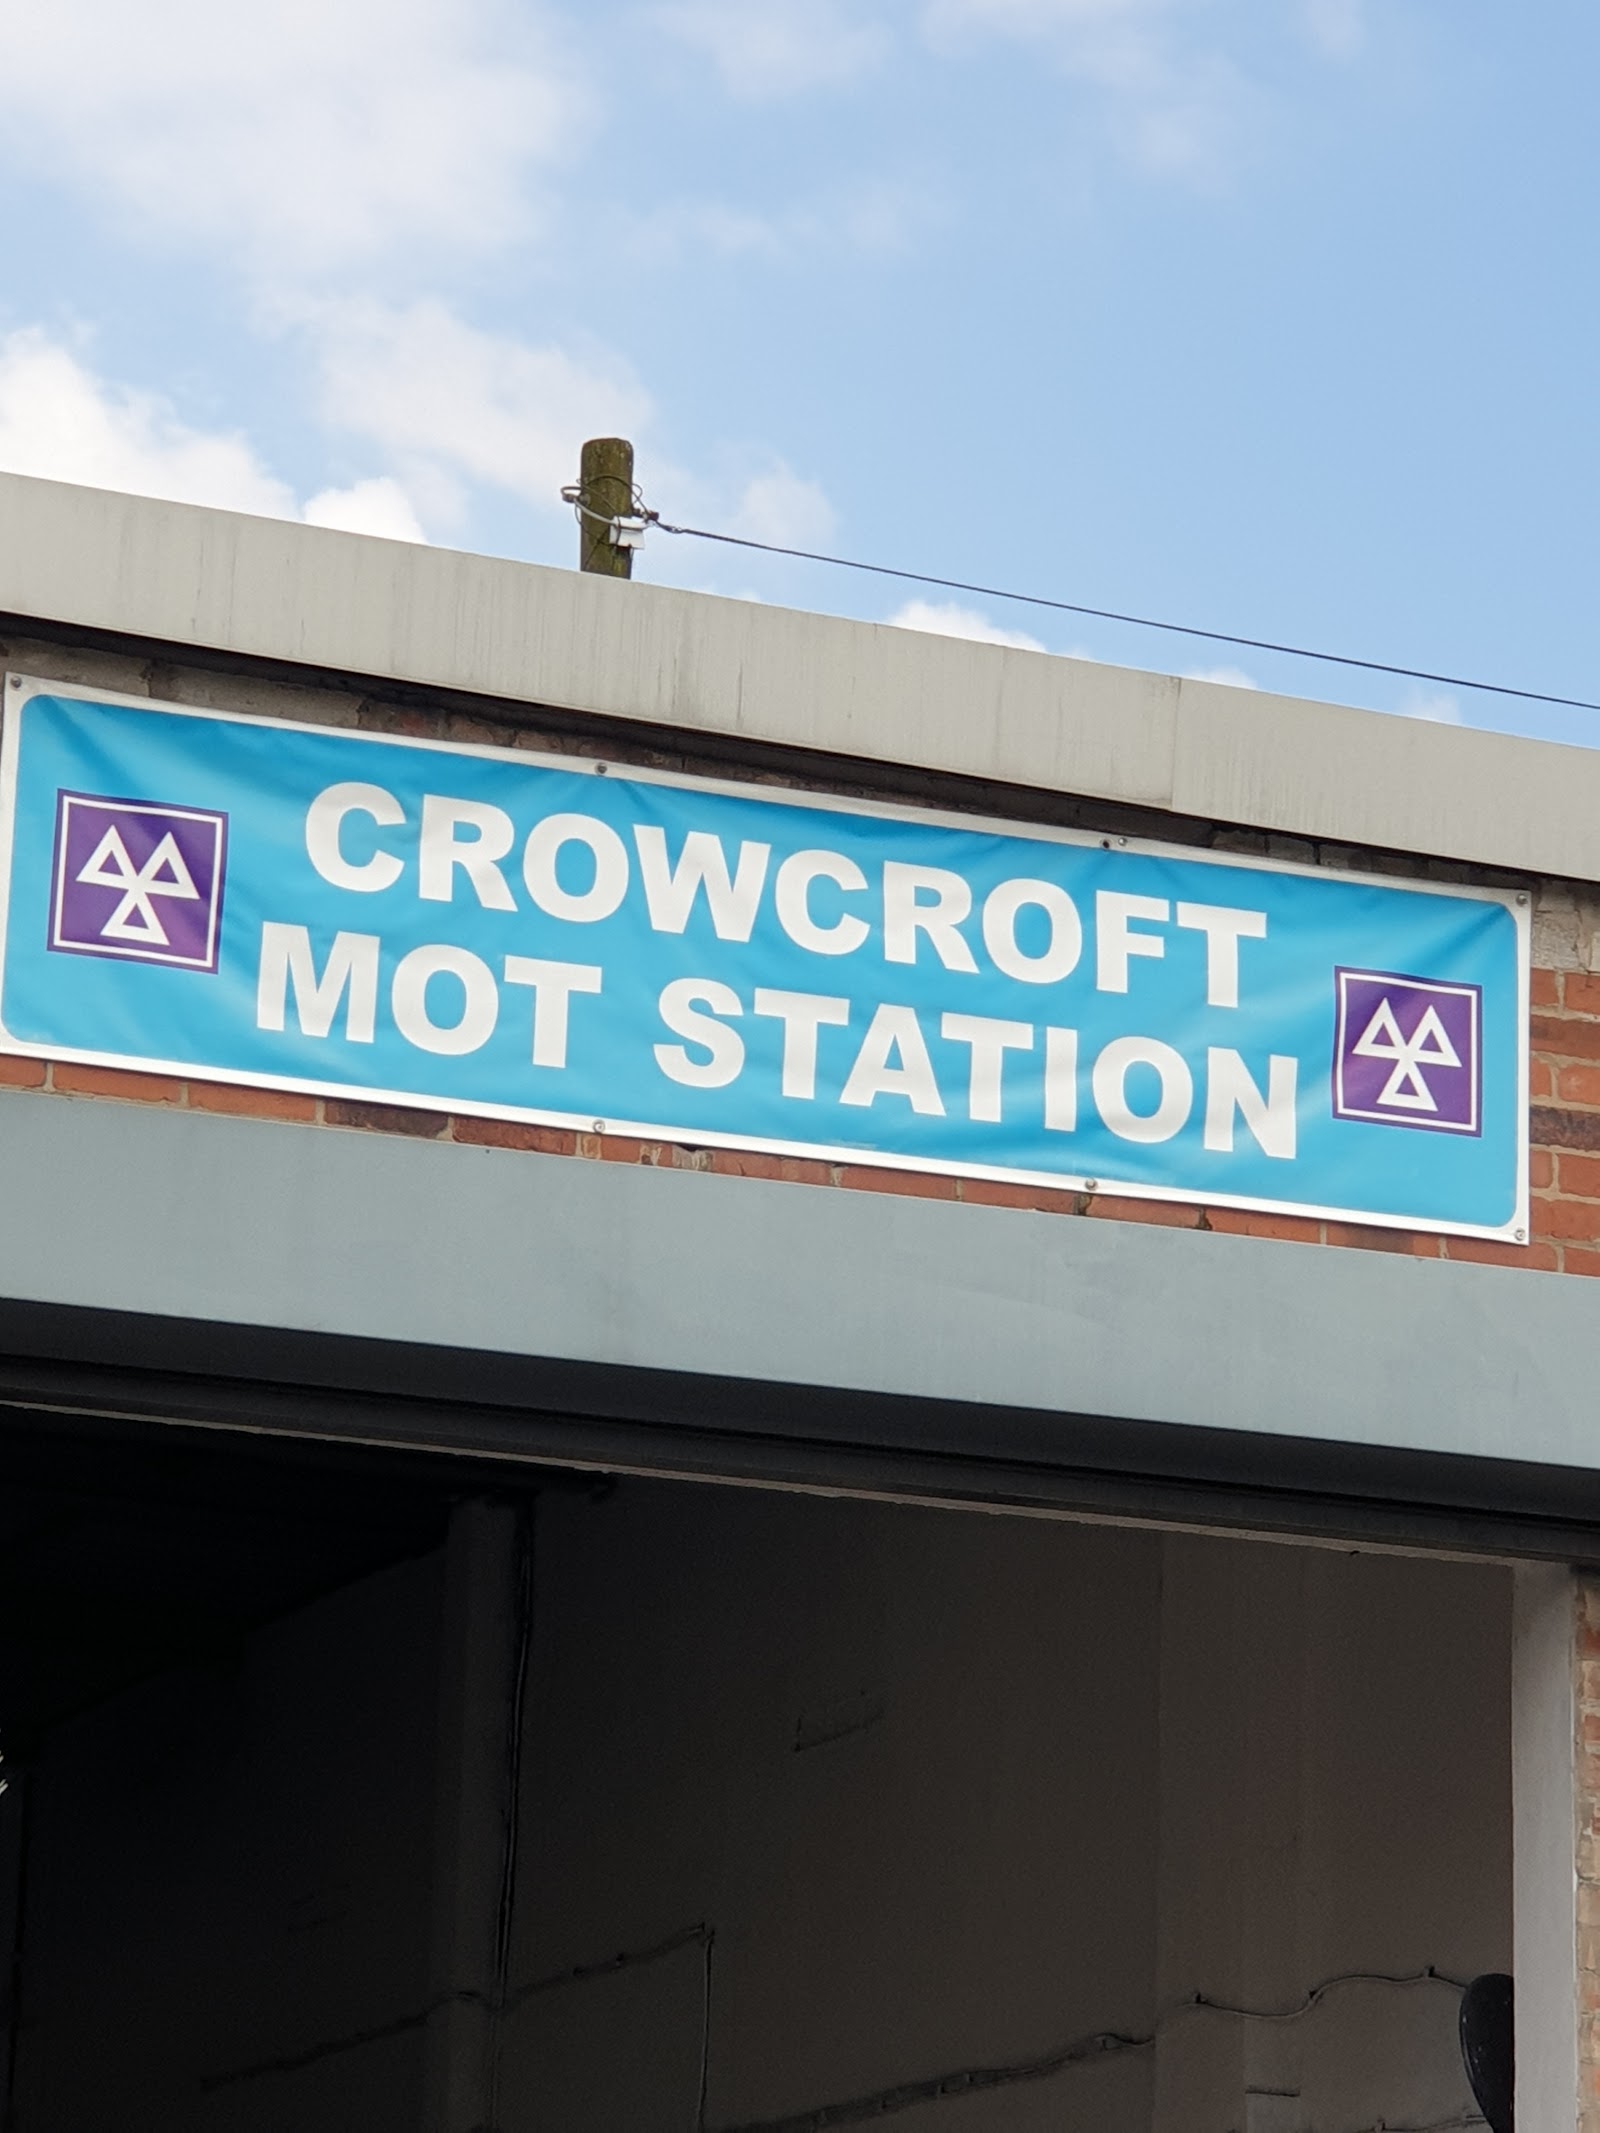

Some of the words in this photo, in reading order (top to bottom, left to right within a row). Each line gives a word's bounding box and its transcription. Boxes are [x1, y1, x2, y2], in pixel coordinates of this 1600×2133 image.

[304, 782, 1268, 1011] CROWCROFT
[255, 921, 603, 1069] MOT
[652, 977, 1299, 1160] STATION
